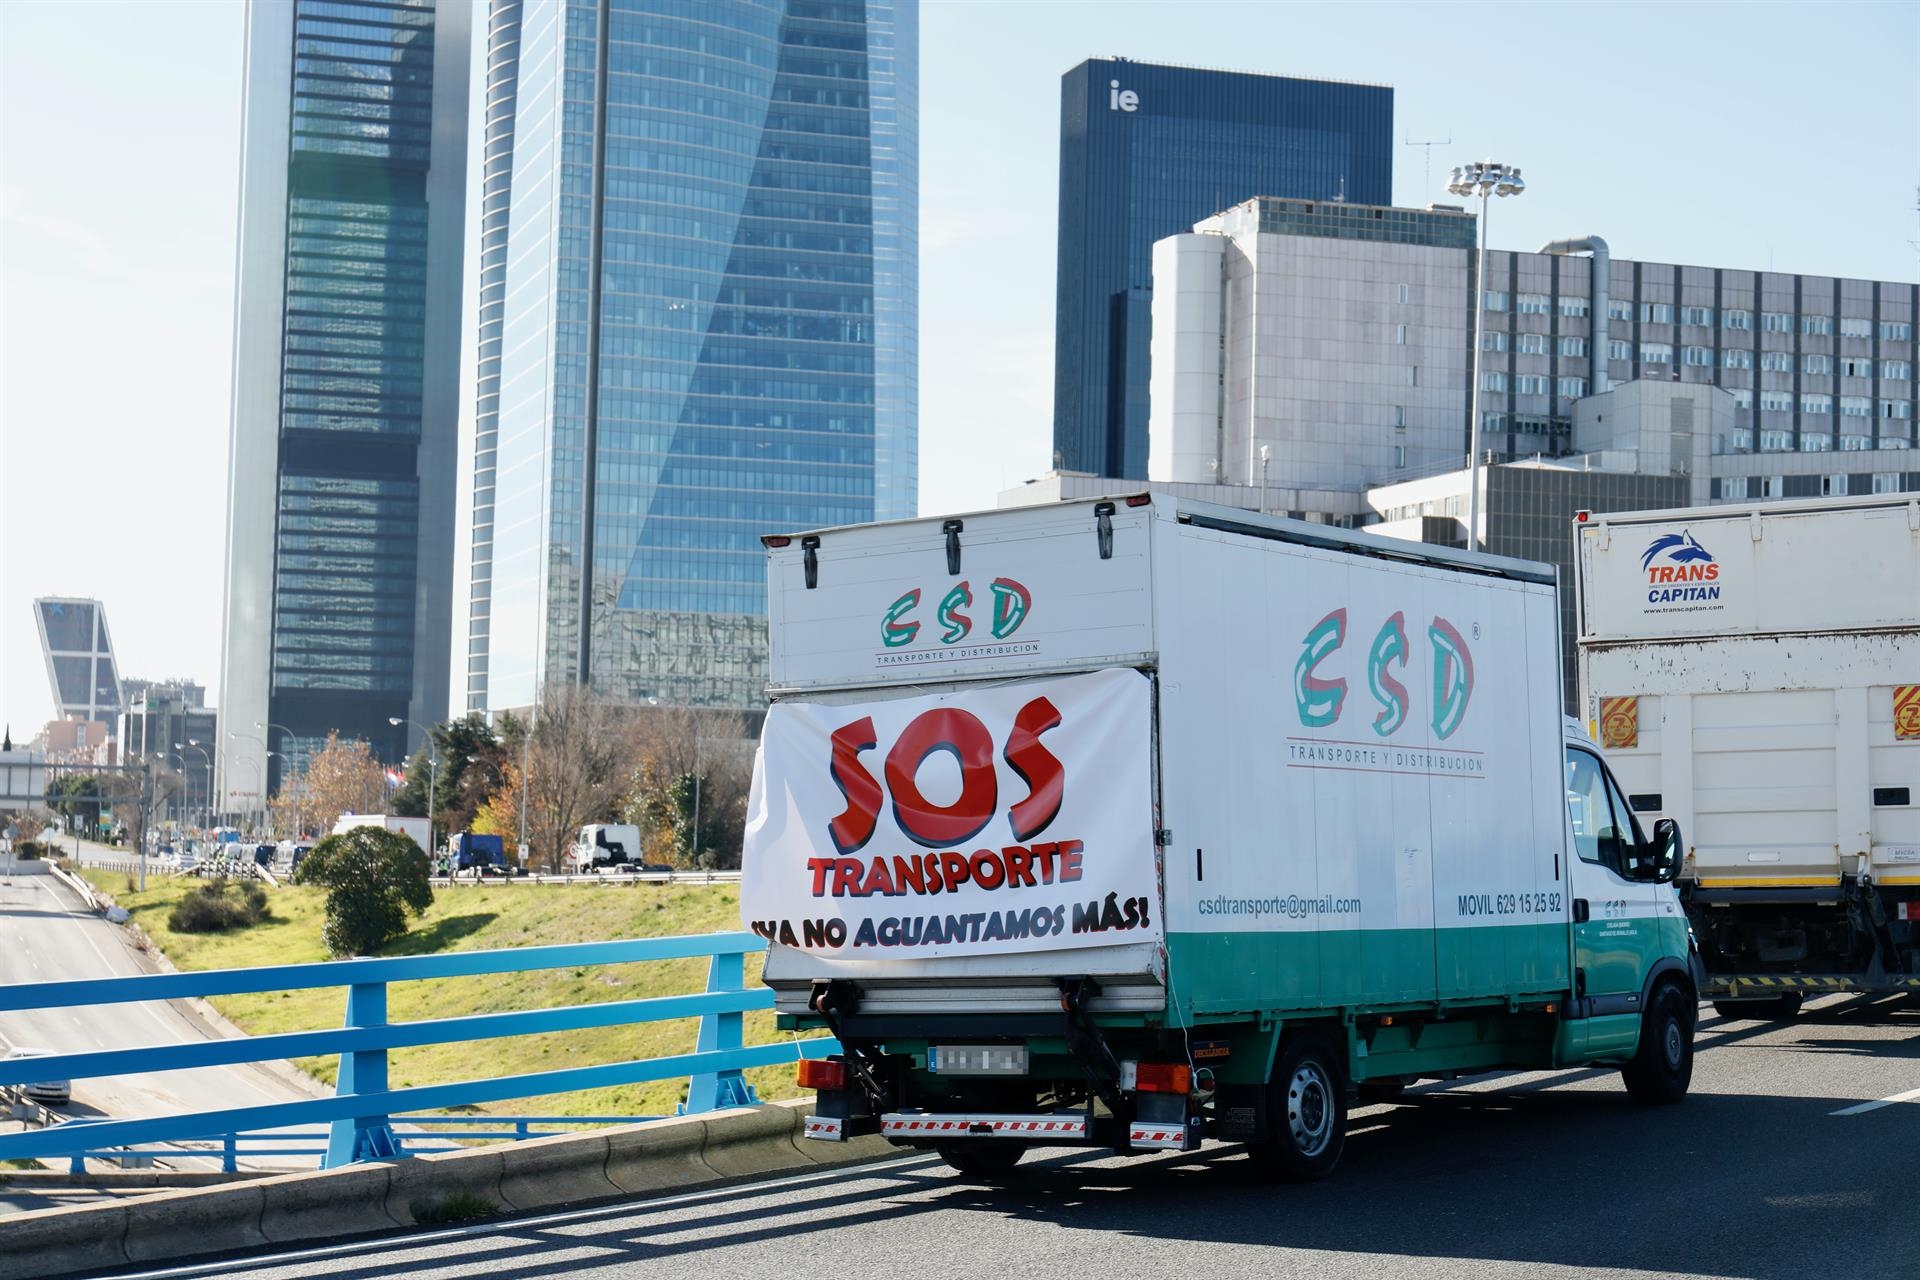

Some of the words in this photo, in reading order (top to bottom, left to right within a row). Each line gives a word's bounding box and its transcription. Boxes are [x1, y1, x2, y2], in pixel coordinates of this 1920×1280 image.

[1110, 79, 1139, 112] ie
[1648, 563, 1720, 584] TRANS
[1648, 586, 1720, 603] CAPITAN
[880, 577, 1033, 648] CSD
[1643, 605, 1724, 614] www.transcapitan.com
[876, 651, 944, 664] TRANSPORTE
[949, 649, 957, 658] Y
[960, 643, 1040, 657] DISTRIBUCION
[1293, 607, 1475, 741] CSD
[1289, 745, 1377, 765] TRANSPORTE
[1383, 750, 1390, 764] Y
[1396, 751, 1484, 772] DISTRIBUCION
[828, 696, 1066, 854] SOS
[806, 839, 1085, 898] TRANSPORTE
[1198, 894, 1361, 920] csdtransporte@gmail.com
[1458, 895, 1494, 916] MOVIL
[1497, 894, 1516, 914] 629
[1519, 893, 1532, 914] 15
[1534, 893, 1547, 913] 25
[1548, 892, 1561, 912] 92
[803, 917, 848, 949] NO
[854, 904, 1066, 948] AGUANTAMOS
[1071, 891, 1150, 934] MÁS!
